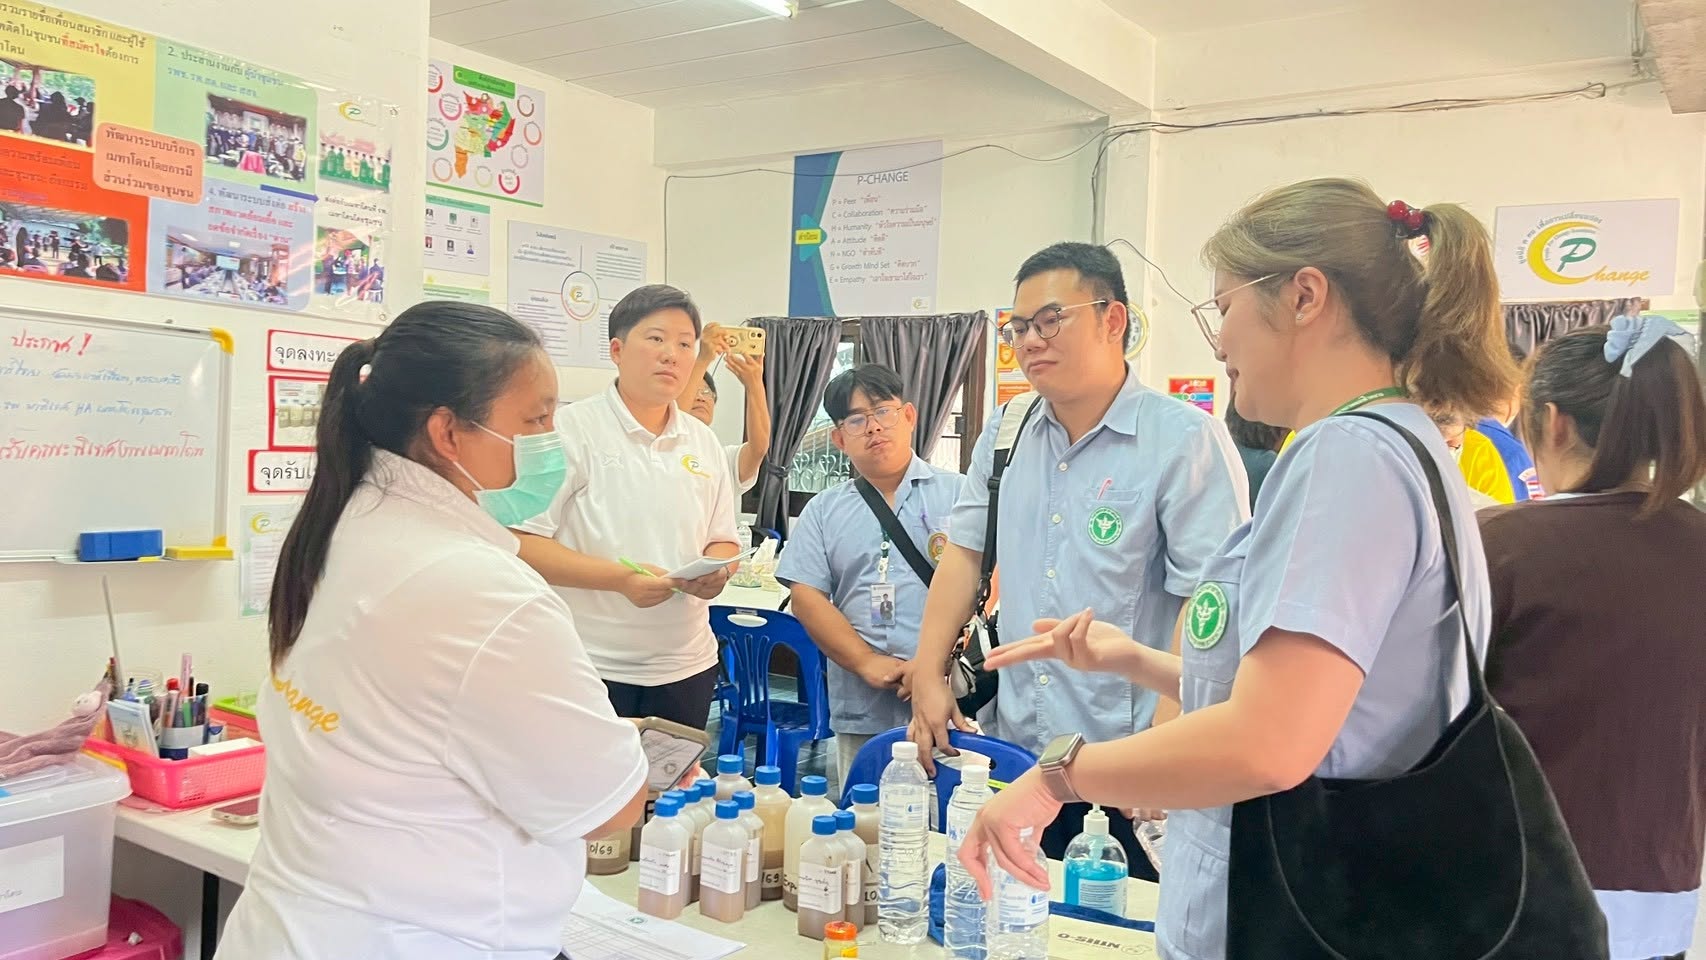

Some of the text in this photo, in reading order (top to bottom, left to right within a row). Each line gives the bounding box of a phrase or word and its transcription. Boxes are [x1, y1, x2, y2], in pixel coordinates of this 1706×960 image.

[0, 3, 108, 38] รวมรายชื่อเพื่อนสมาชิก
[105, 127, 196, 157] พัฒนาระบบบริการ
[106, 151, 193, 177] เมทาโดนโดยการมี
[103, 170, 194, 198] ส่วนร่วมของชุมชน
[857, 171, 909, 185] P-CHANGE
[843, 209, 883, 218] Collaboration
[843, 223, 872, 231] Humanity
[842, 236, 866, 244] Attitude
[841, 262, 862, 270] Growth
[880, 261, 890, 269] Set
[840, 275, 866, 284] Empathy
[11, 329, 75, 352] ประกาศ
[275, 346, 338, 364] จุดลงทะ
[261, 461, 316, 485] จุดรับเ
